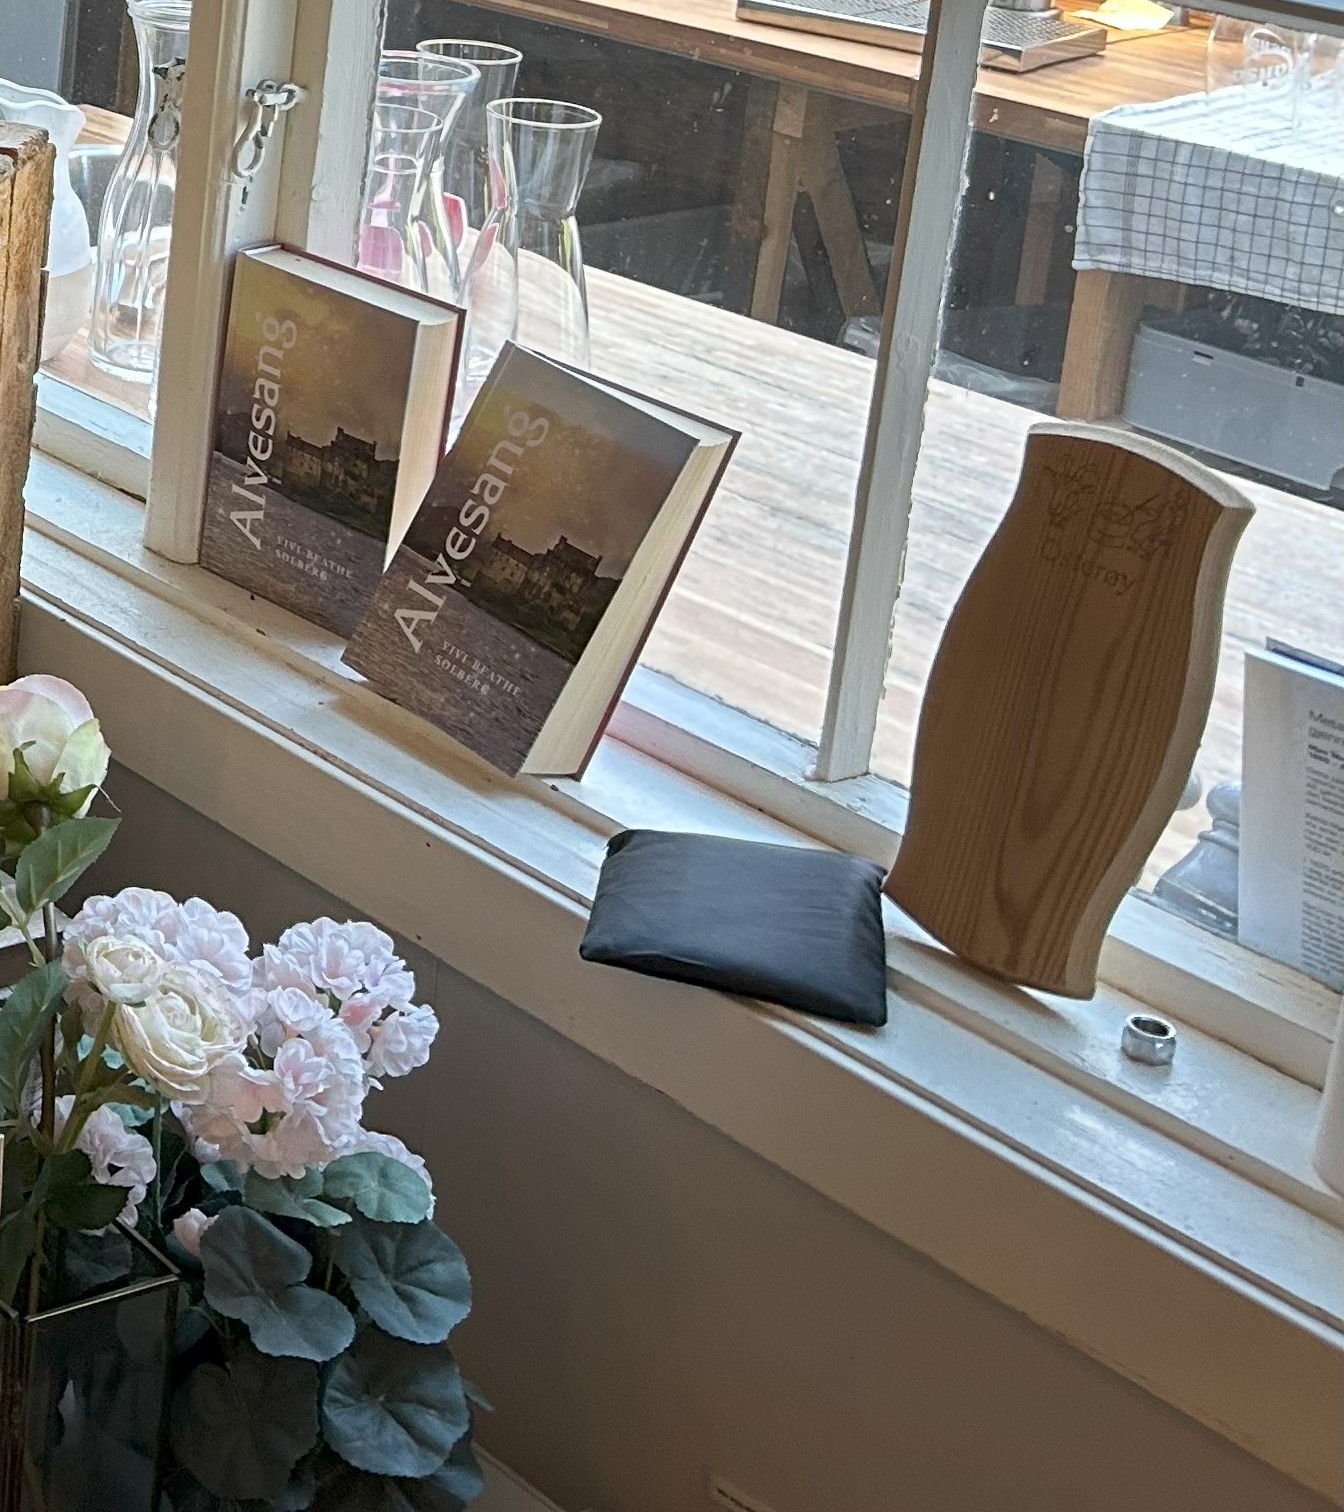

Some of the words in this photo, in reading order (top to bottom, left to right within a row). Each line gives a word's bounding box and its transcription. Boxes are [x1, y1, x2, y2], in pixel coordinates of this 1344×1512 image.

[229, 310, 298, 550] Alvesang
[275, 549, 328, 582] SOLBERG
[393, 407, 550, 653] Alvesang
[433, 654, 491, 696] SOLBERG
